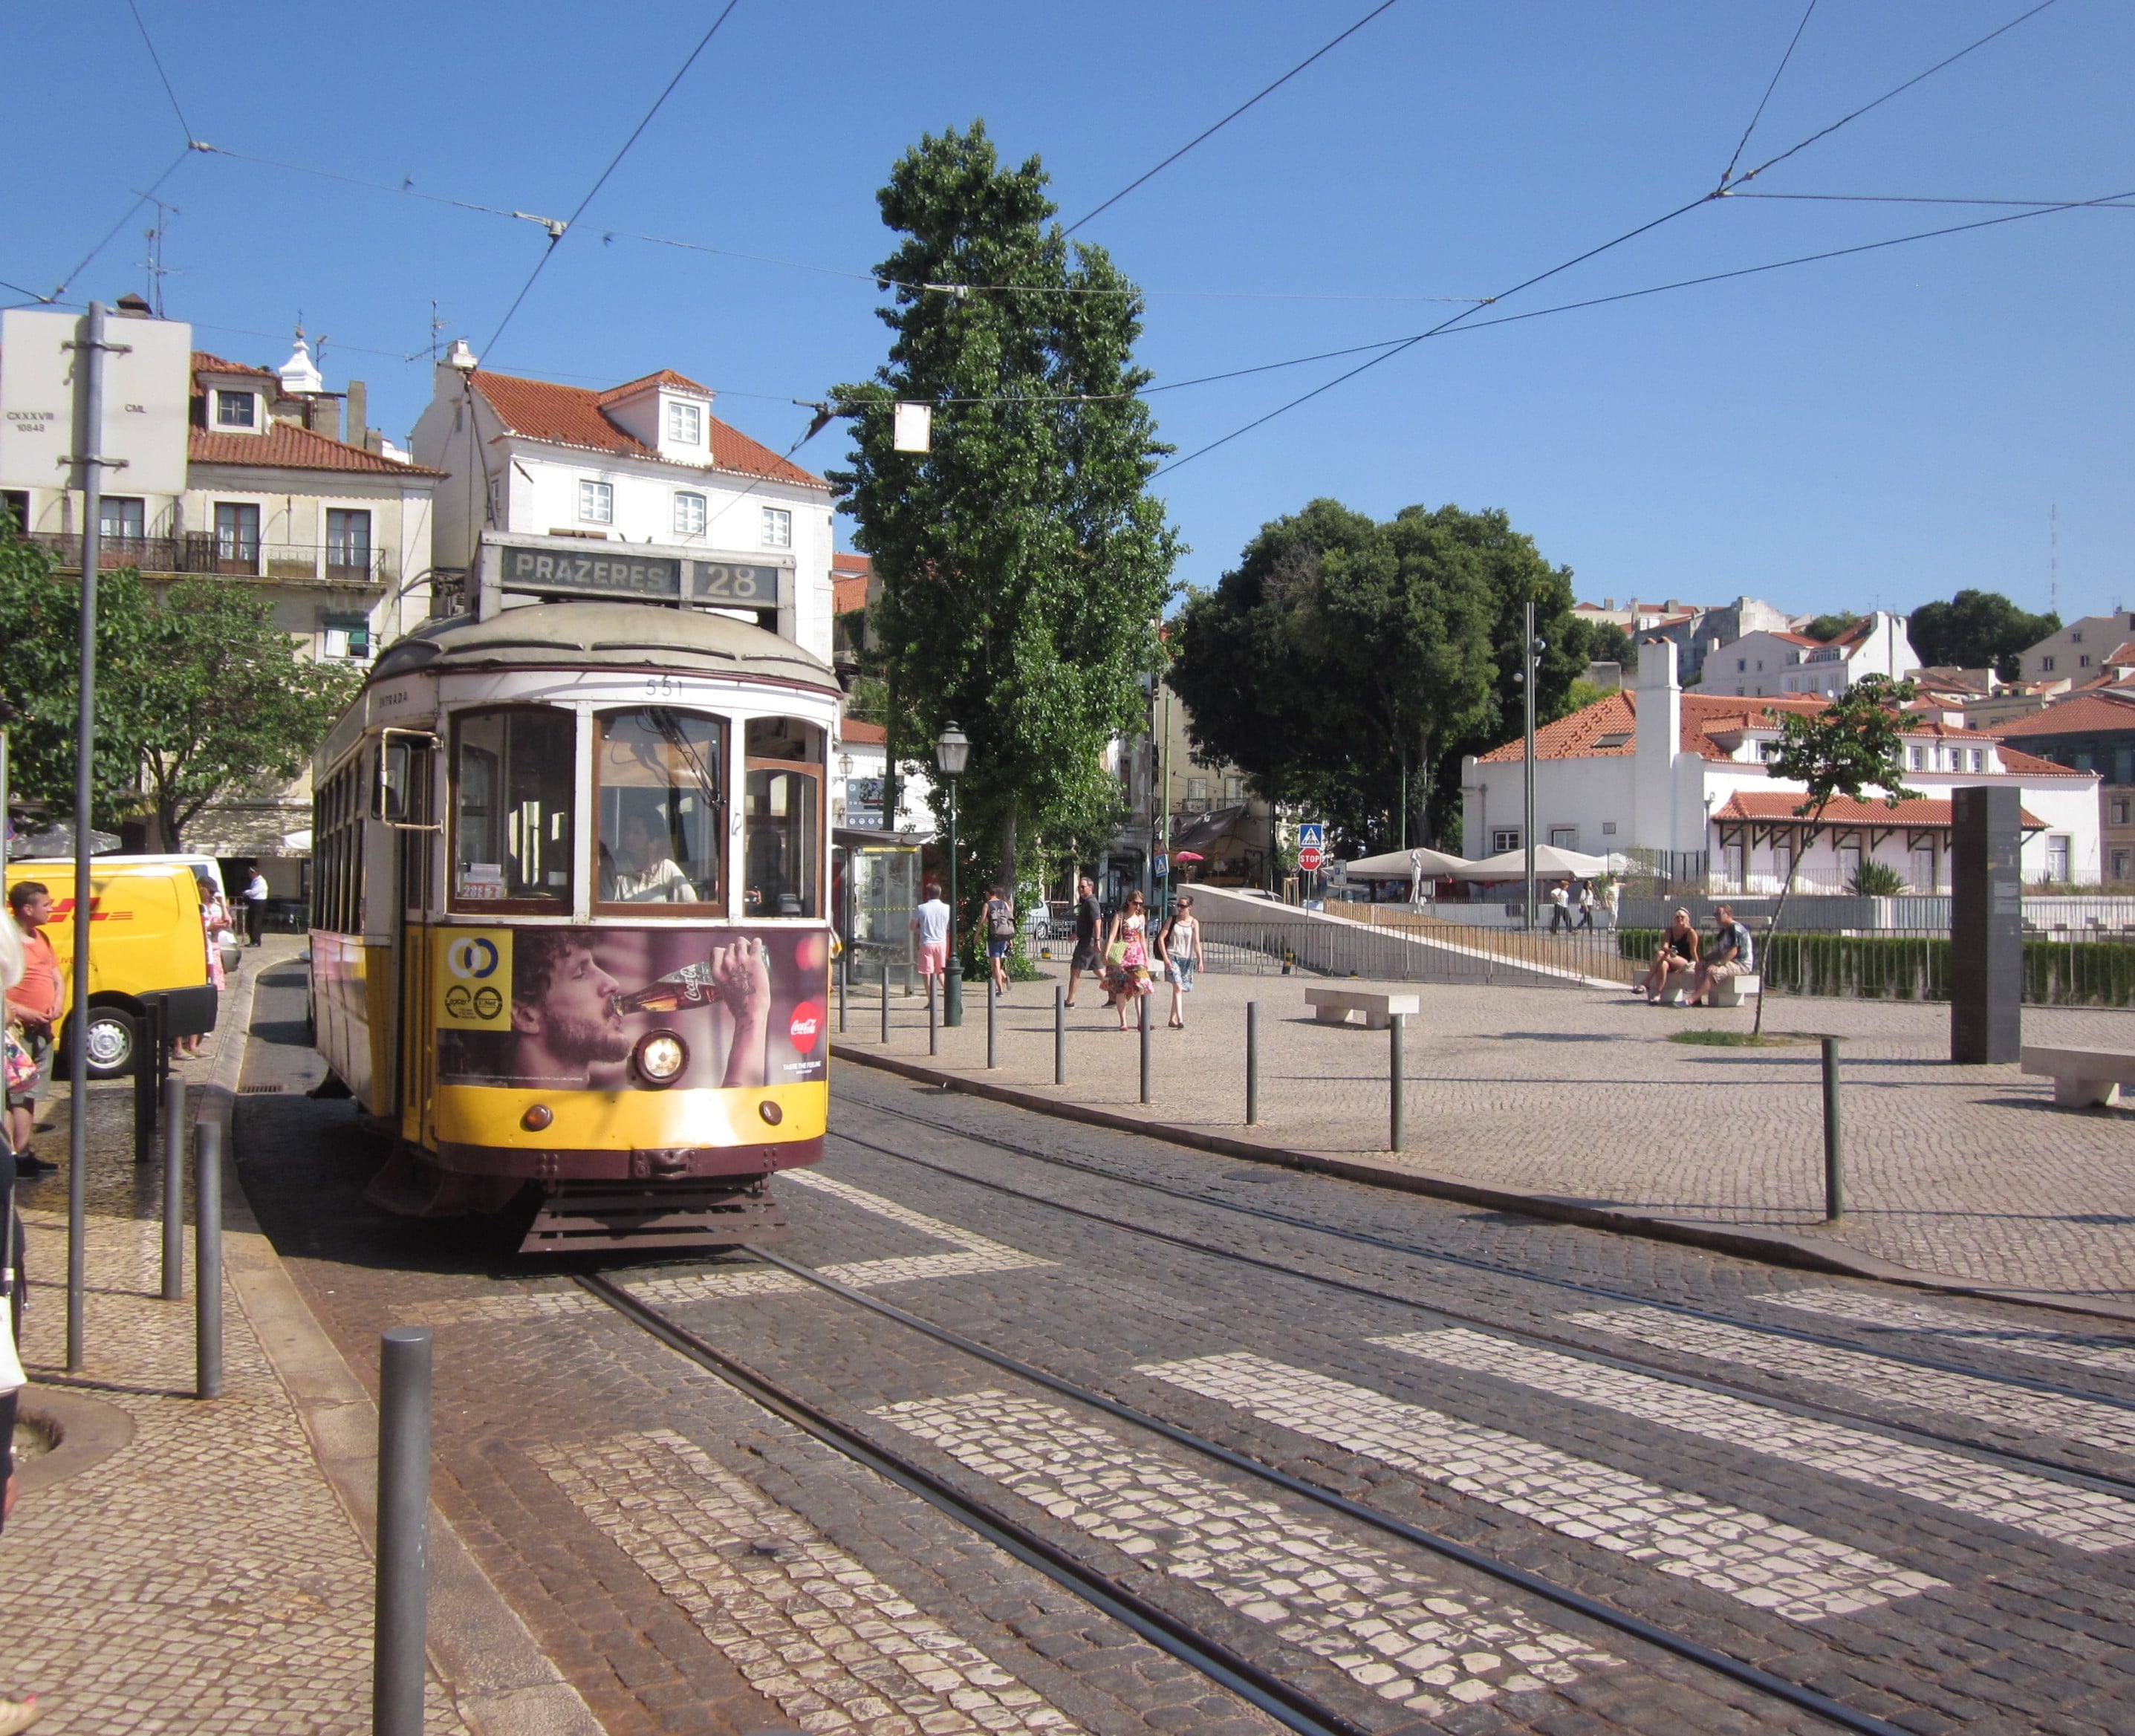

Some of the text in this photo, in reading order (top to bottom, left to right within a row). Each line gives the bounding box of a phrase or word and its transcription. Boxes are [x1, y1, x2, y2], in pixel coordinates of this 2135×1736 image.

[125, 403, 147, 414] CML
[516, 553, 757, 597] PRAZERES 28
[646, 679, 682, 696] 551
[1300, 855, 1320, 863] STOP
[790, 1018, 817, 1036] Coca-Cola
[782, 1062, 798, 1070] TASTE
